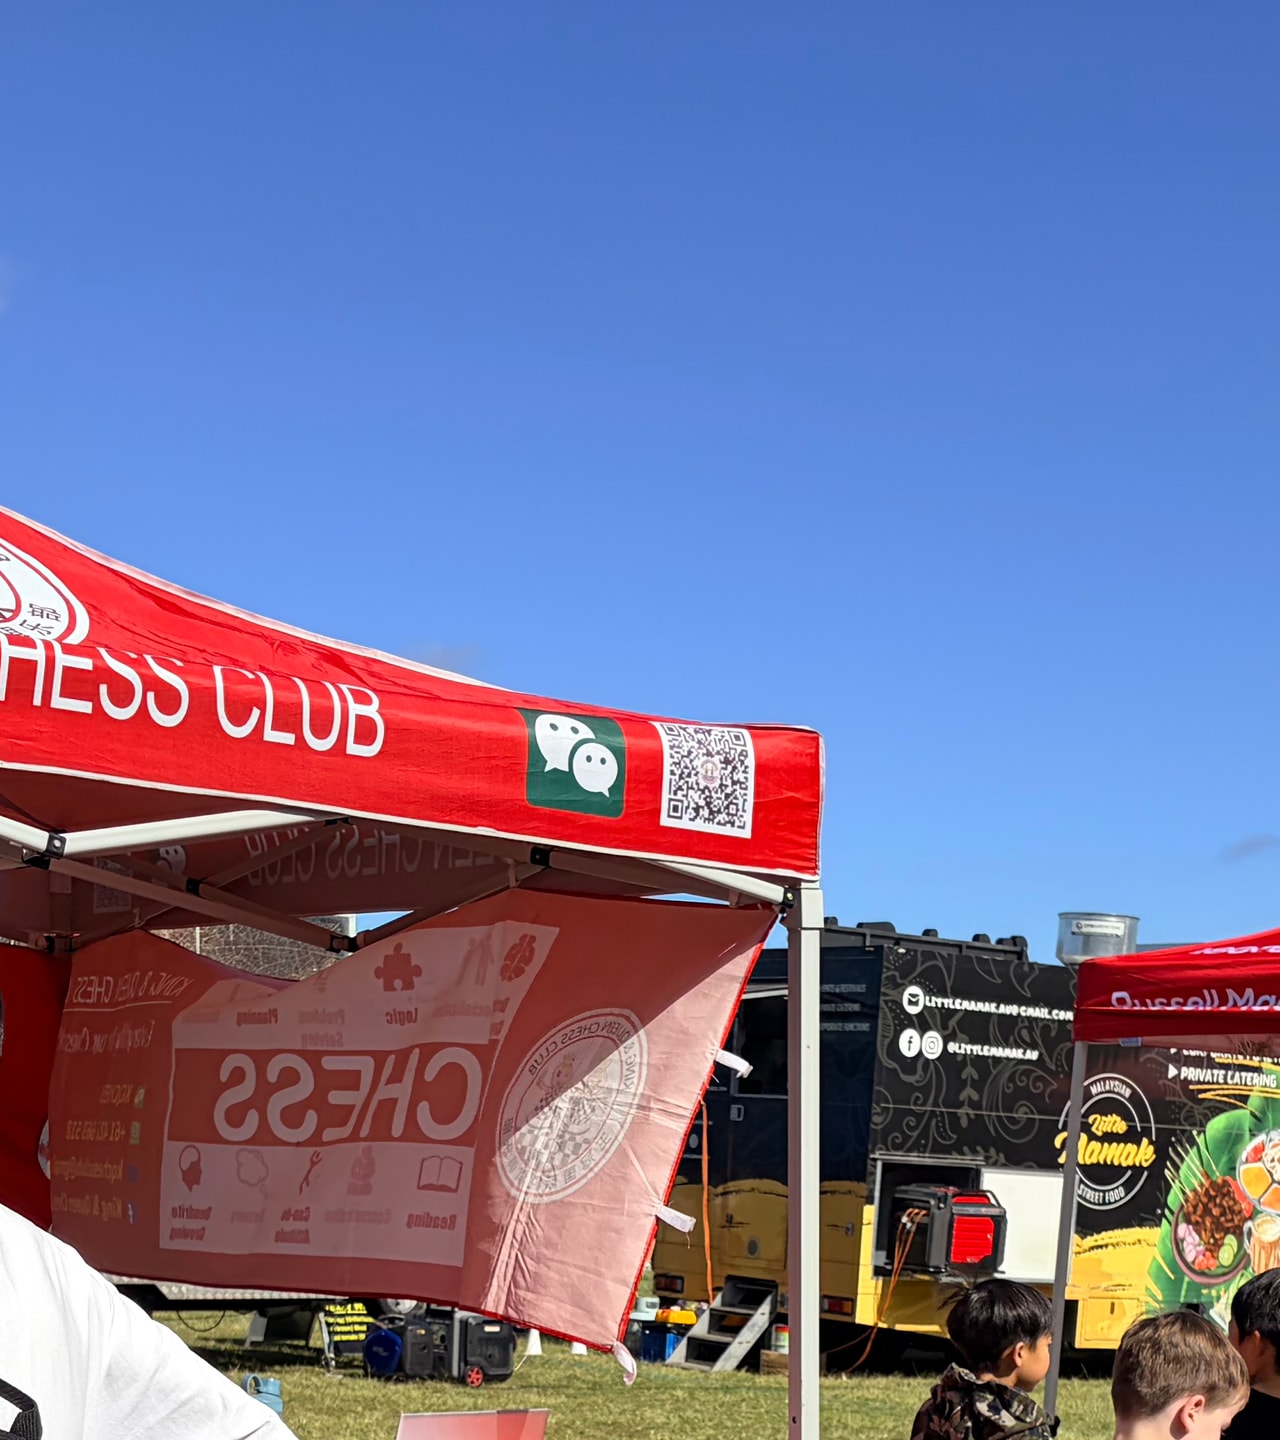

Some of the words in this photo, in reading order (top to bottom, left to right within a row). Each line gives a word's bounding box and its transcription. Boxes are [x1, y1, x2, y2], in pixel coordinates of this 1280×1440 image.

[212, 664, 386, 759] CLUB
[1180, 1066, 1226, 1085] PRIVATE
[1227, 1071, 1278, 1089] CATERING
[1090, 1080, 1132, 1099] MALAYSIAN
[1088, 1113, 1129, 1137] Little
[1104, 1187, 1126, 1204] FOOD
